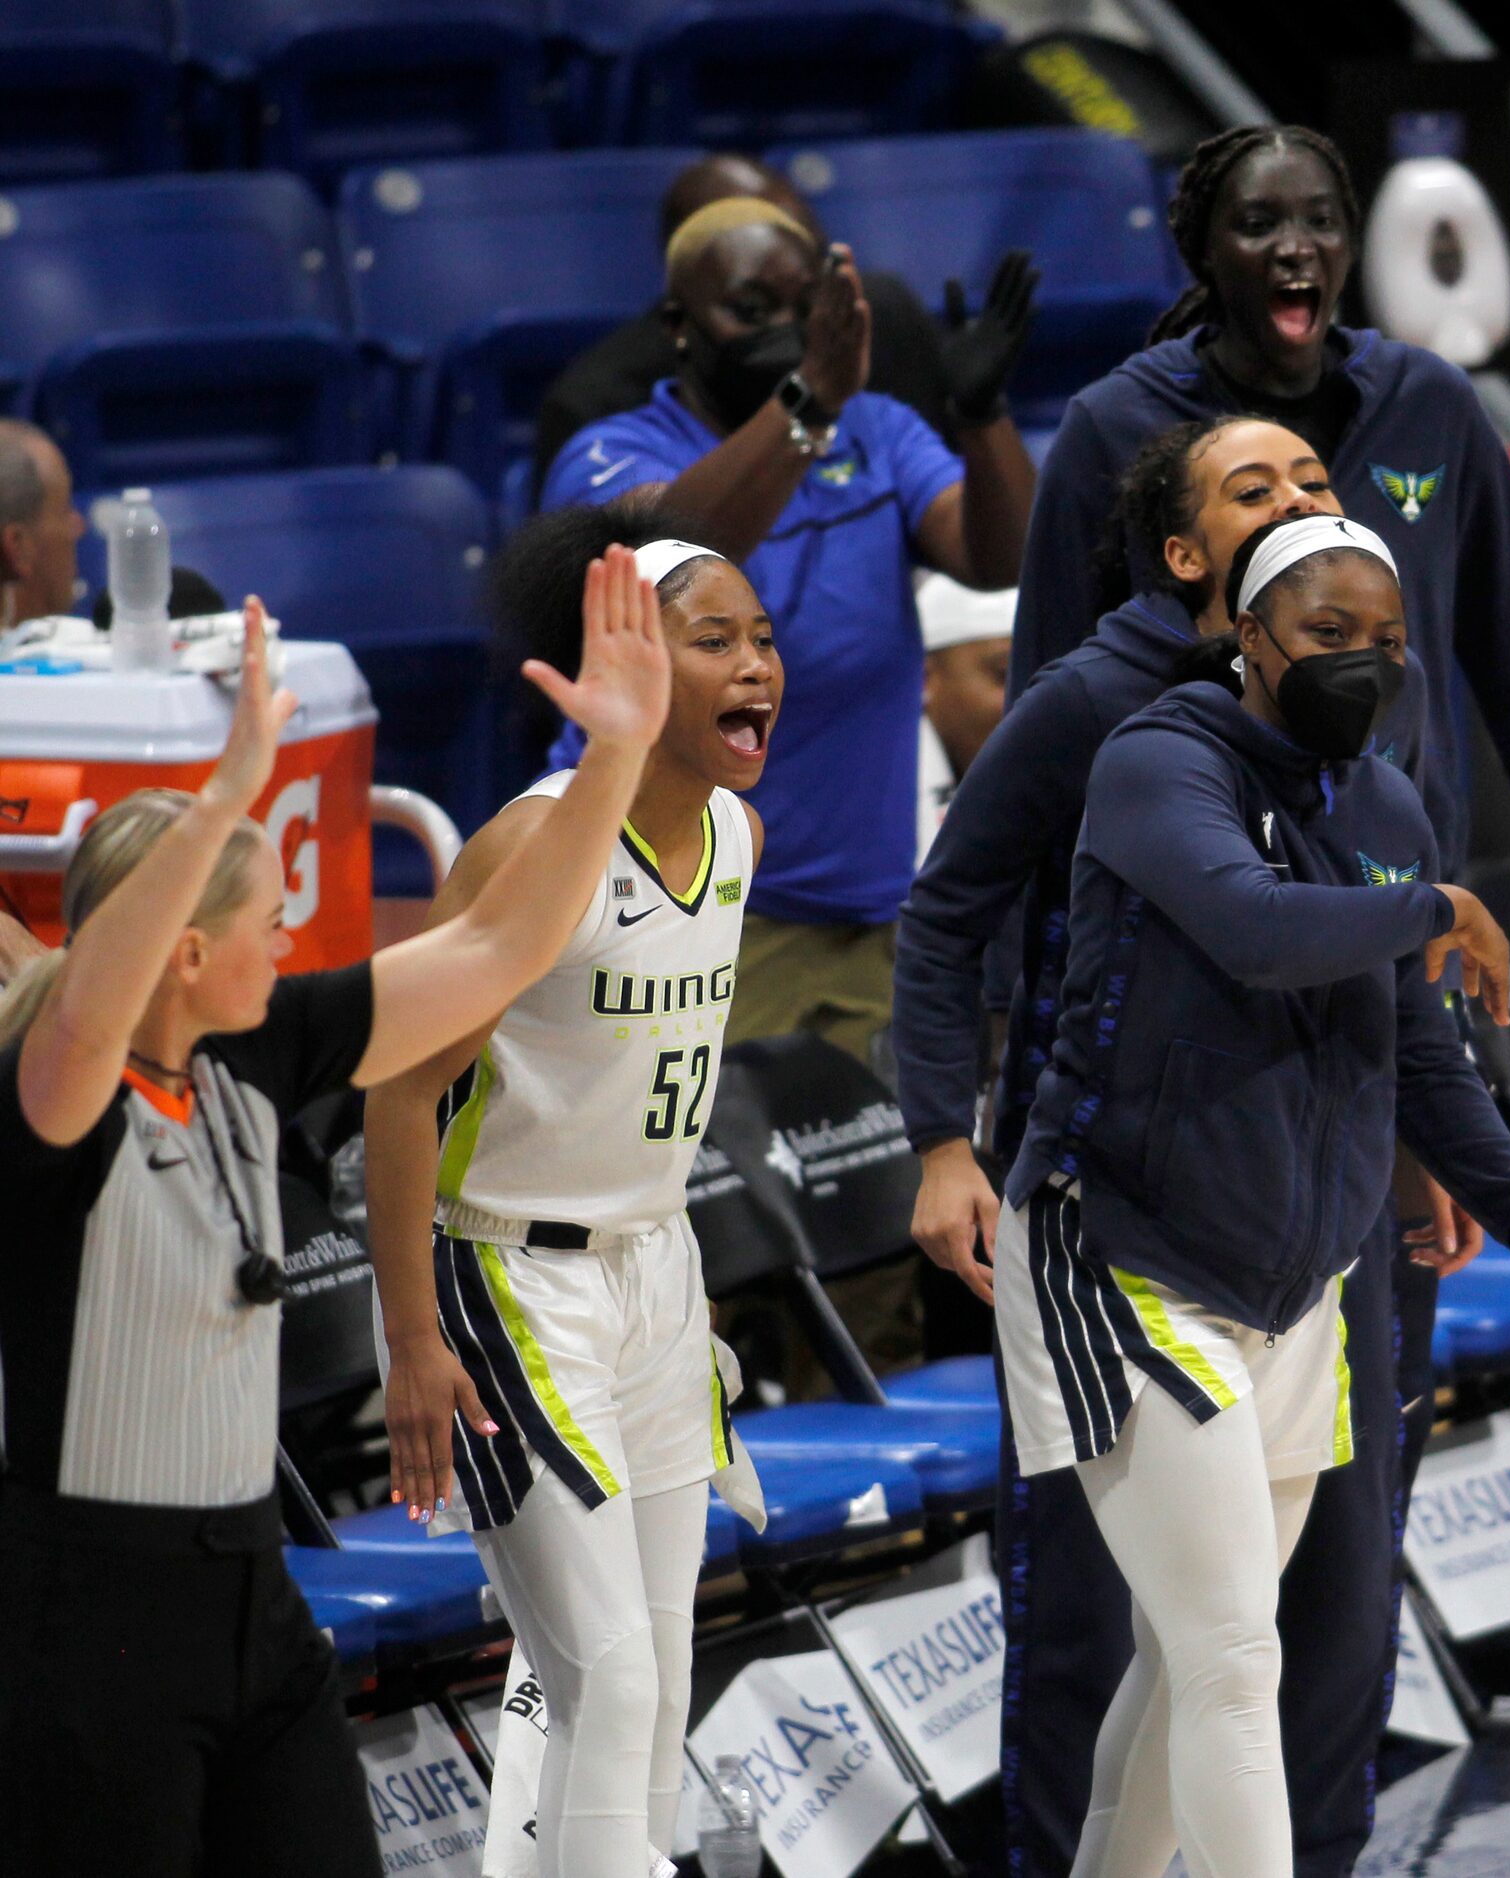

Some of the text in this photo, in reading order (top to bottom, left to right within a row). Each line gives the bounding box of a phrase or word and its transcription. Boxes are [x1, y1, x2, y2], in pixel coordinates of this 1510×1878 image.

[266, 774, 321, 929] G
[590, 963, 738, 1018] WING
[641, 1041, 711, 1143] 52
[367, 1757, 481, 1836] ASLIFE
